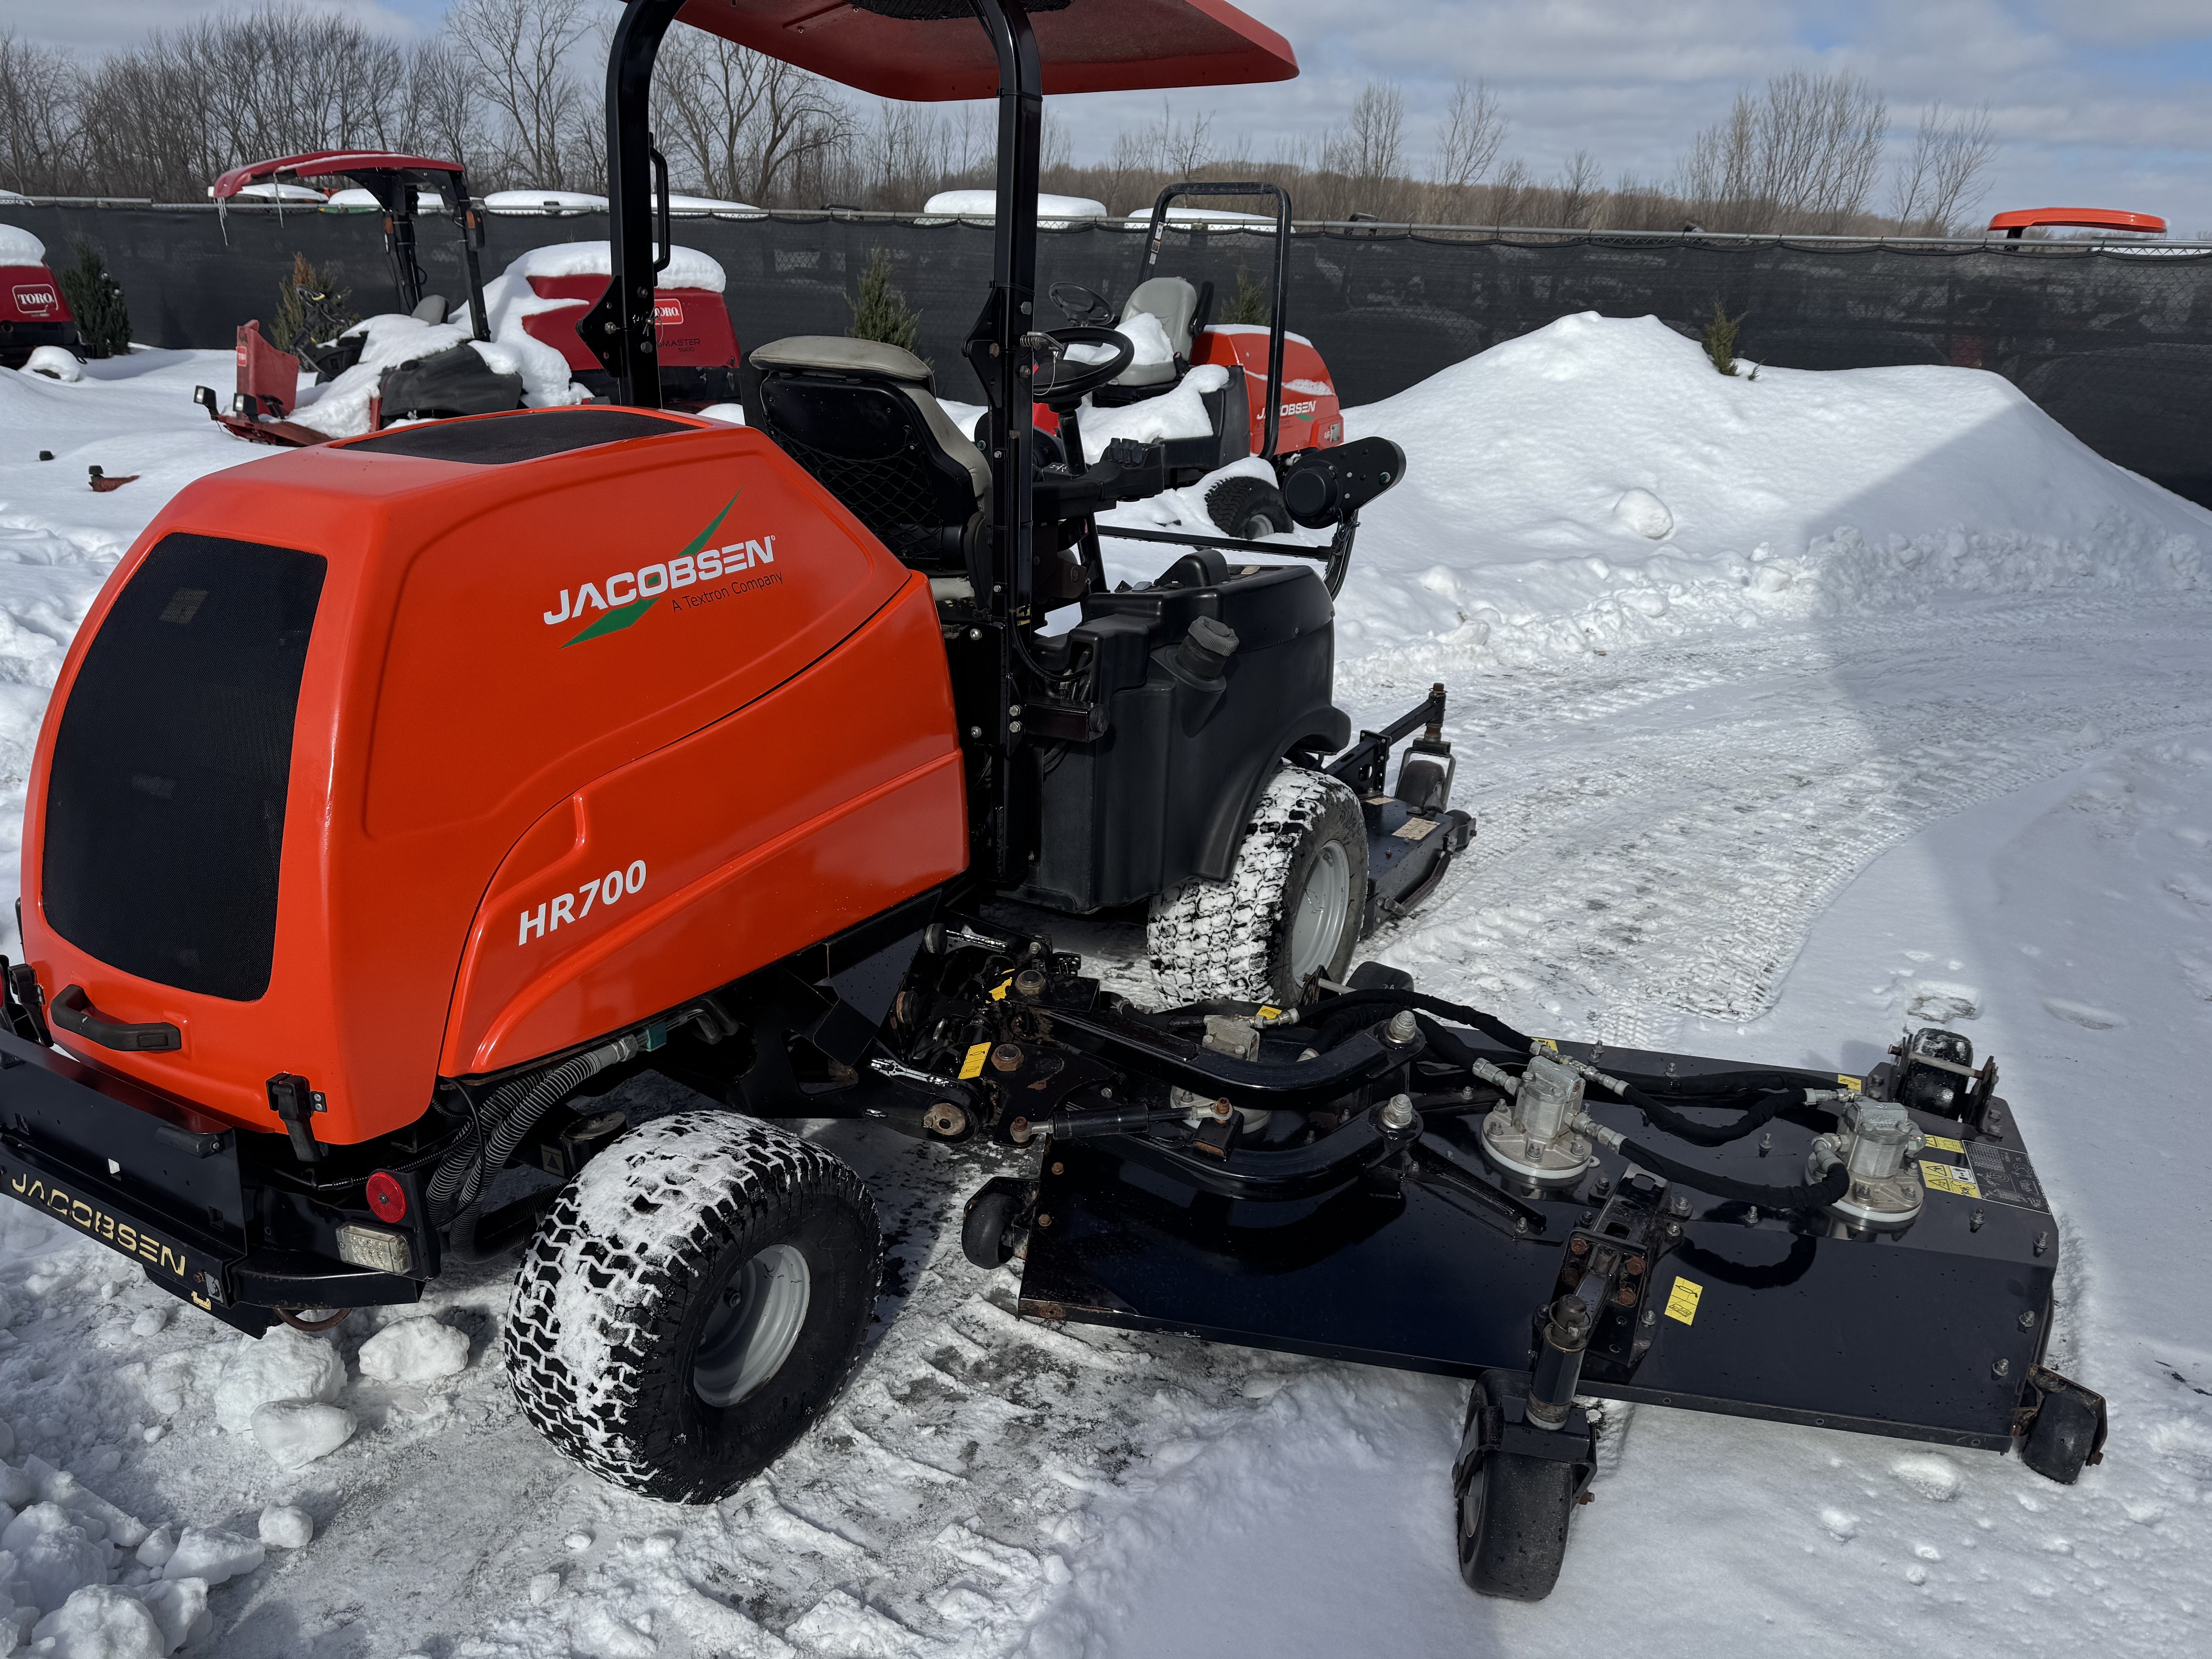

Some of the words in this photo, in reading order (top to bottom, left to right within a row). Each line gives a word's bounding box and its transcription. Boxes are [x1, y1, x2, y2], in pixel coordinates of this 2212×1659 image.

[17, 293, 53, 304] TORO
[1257, 400, 1316, 419] JOBSEN
[543, 536, 774, 625] JACOBSEN
[672, 599, 682, 613] A
[682, 586, 730, 609] Textron
[731, 572, 783, 594] Company
[519, 860, 646, 946] HR700
[12, 1173, 185, 1276] JACOBSEN
